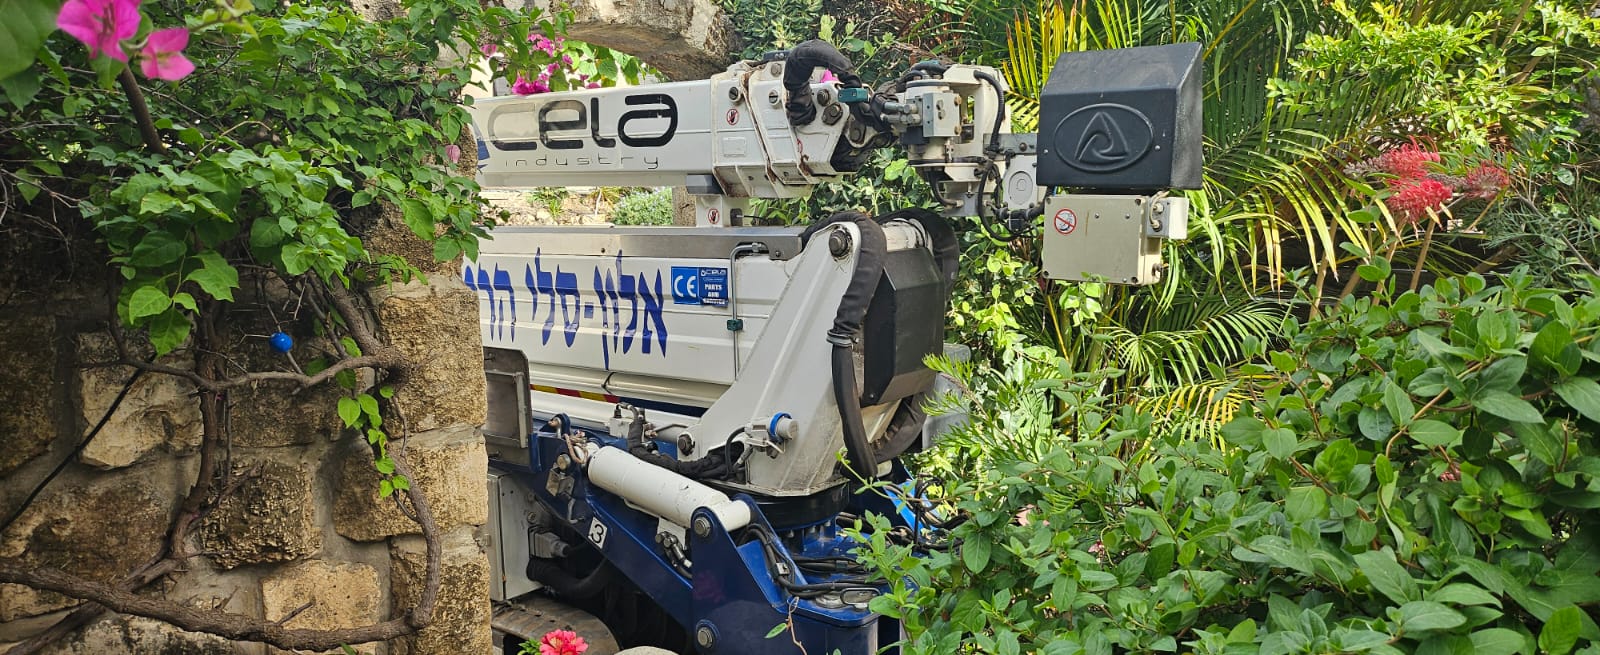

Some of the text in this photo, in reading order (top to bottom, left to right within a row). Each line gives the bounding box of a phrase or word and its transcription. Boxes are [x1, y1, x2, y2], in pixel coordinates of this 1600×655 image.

[487, 93, 678, 151] cela
[505, 153, 659, 170] industry
[673, 275, 697, 298] CE
[591, 523, 604, 543] 3
